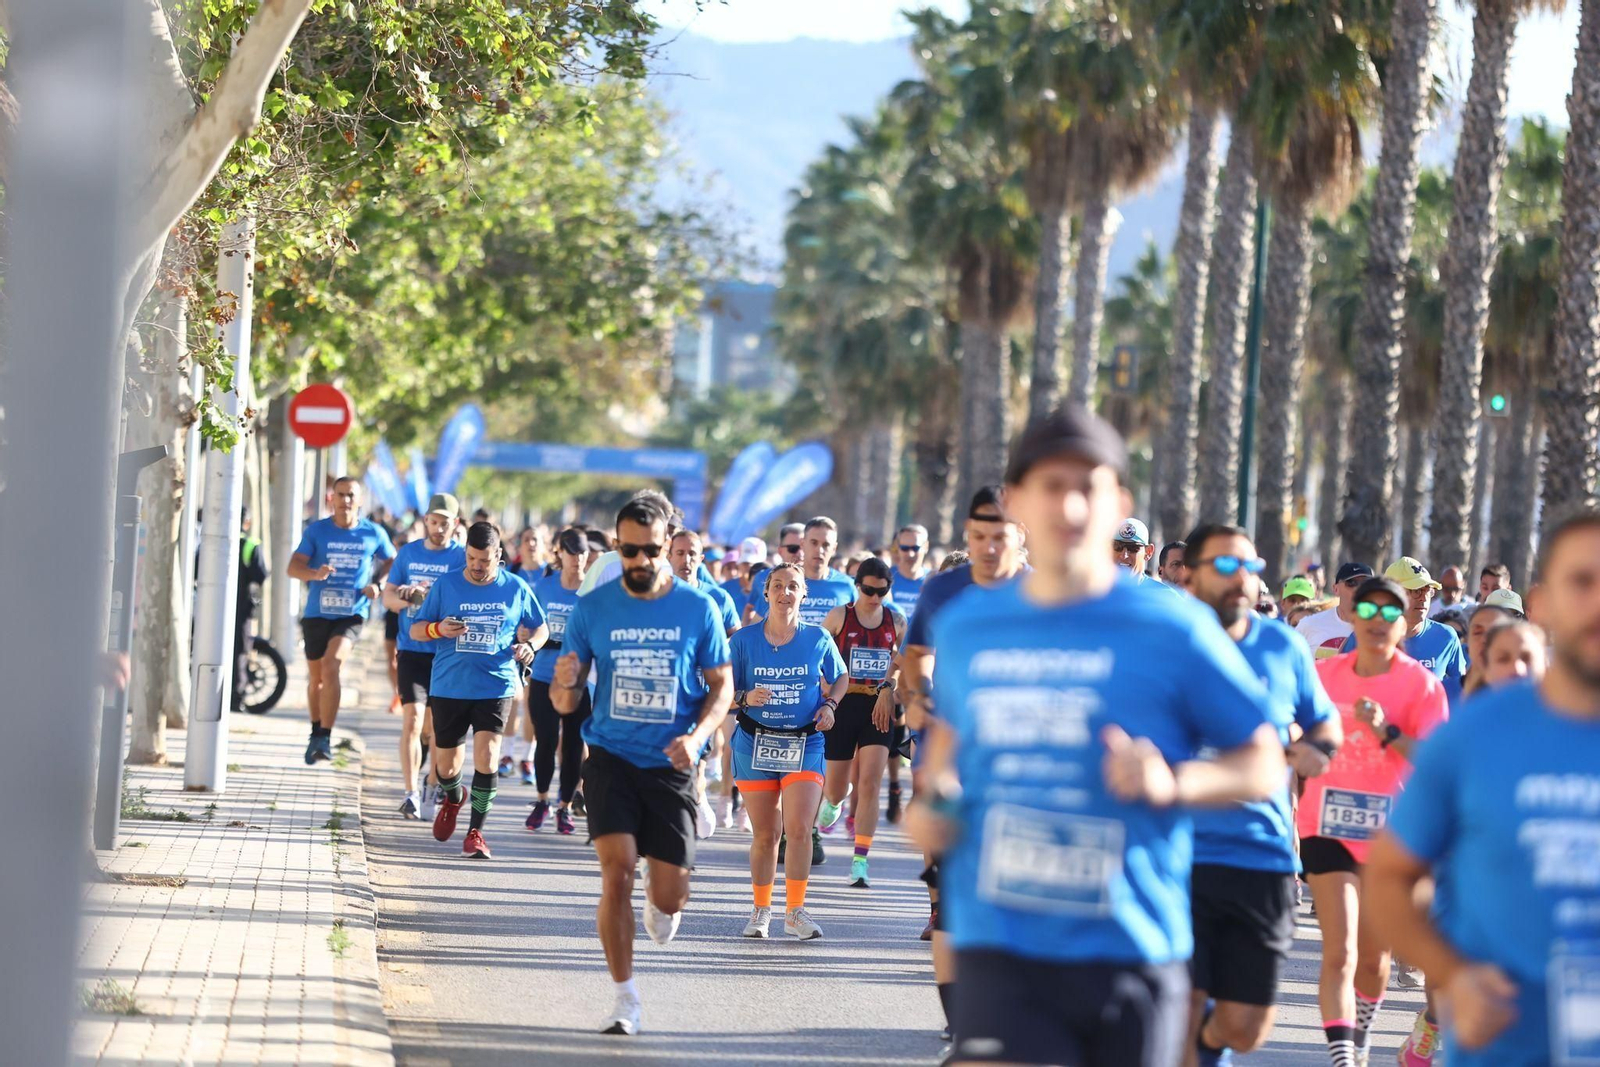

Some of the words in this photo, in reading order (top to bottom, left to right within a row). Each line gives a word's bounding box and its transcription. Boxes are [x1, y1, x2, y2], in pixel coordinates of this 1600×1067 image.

[408, 562, 449, 573] mayoral
[460, 602, 506, 612] mayoral
[547, 602, 574, 612] mayo
[801, 597, 838, 607] ayoral
[610, 626, 681, 644] mayoral
[855, 660, 886, 670] 1542
[754, 664, 809, 679] mayoral
[621, 692, 667, 706] 1971
[771, 690, 800, 698] AKES
[760, 747, 798, 760] 2047
[1329, 807, 1380, 827] 1831
